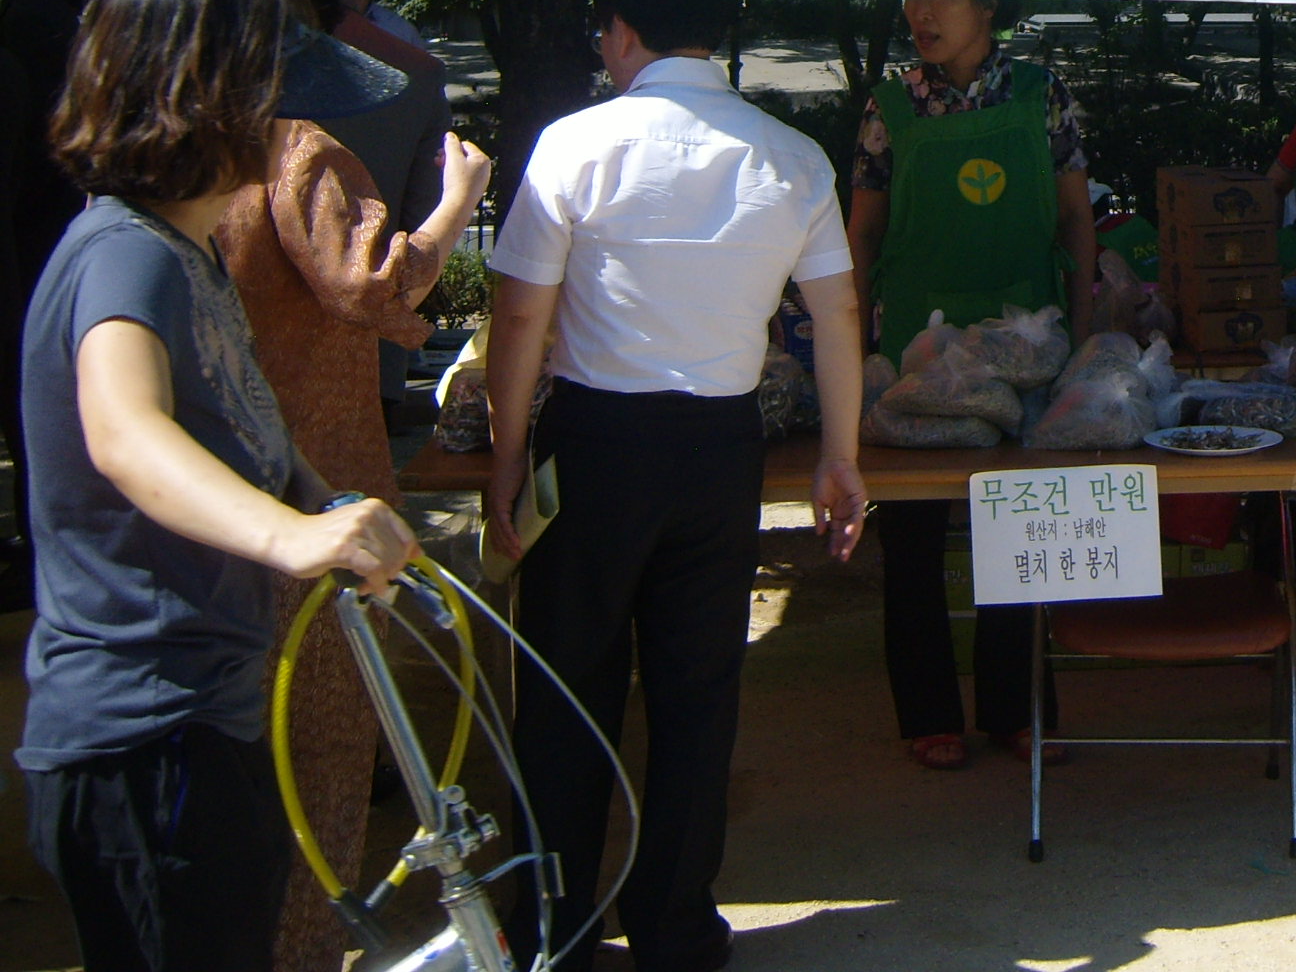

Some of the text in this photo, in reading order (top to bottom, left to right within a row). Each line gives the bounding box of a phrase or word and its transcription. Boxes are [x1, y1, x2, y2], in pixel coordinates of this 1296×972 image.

[979, 471, 1148, 521] 무조건 만원
[1025, 519, 1058, 542] 원산지
[1072, 517, 1107, 541] 남해안
[1014, 545, 1119, 584] 멸치 한 봉지
